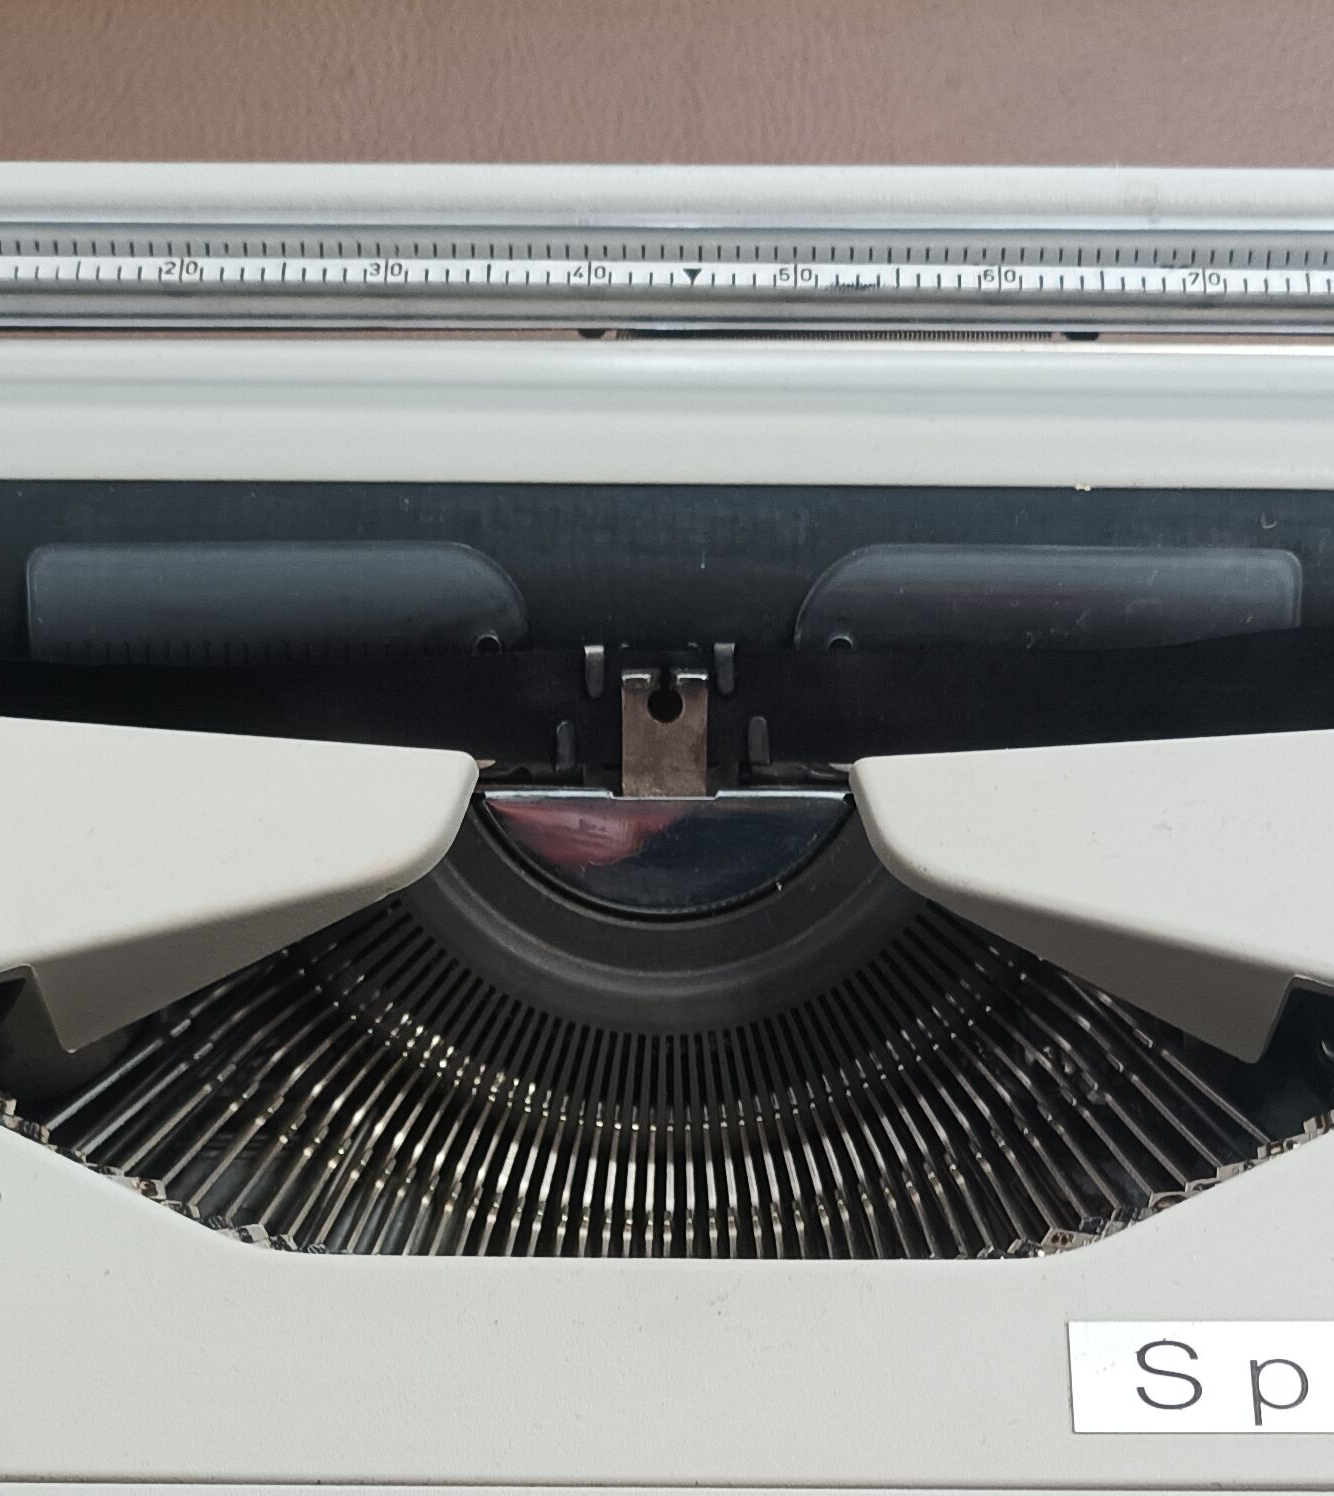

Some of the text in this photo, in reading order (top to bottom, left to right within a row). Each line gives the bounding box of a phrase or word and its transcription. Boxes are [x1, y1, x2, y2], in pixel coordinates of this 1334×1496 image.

[163, 260, 199, 276] 20
[369, 262, 403, 277] 30
[572, 265, 606, 280] 40
[778, 267, 813, 282] 50
[982, 269, 1017, 283] 60
[1188, 271, 1221, 286] 70
